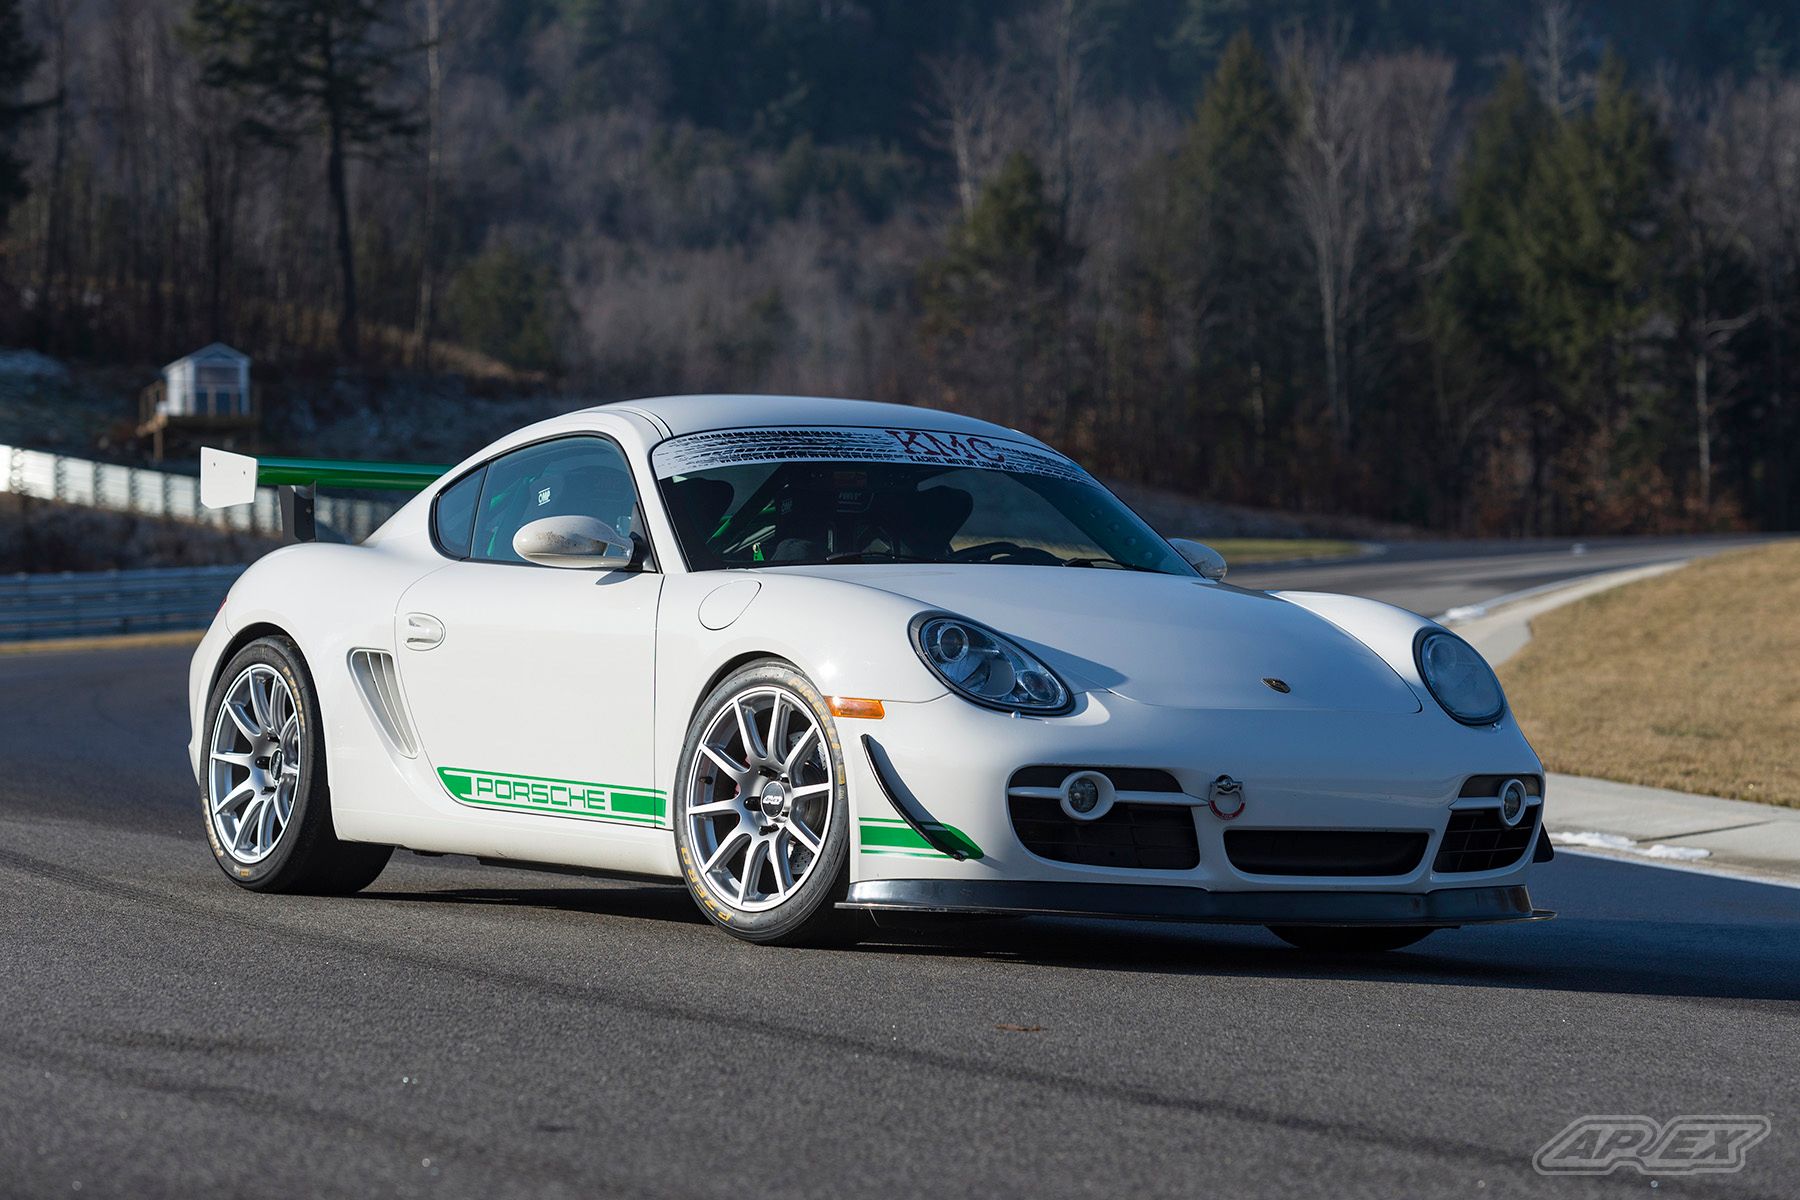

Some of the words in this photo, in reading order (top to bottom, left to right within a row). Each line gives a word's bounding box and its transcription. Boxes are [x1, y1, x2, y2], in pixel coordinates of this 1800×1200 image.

[885, 430, 1005, 463] KMC
[788, 677, 841, 750] PIRELLI
[476, 777, 606, 811] PORSCHE
